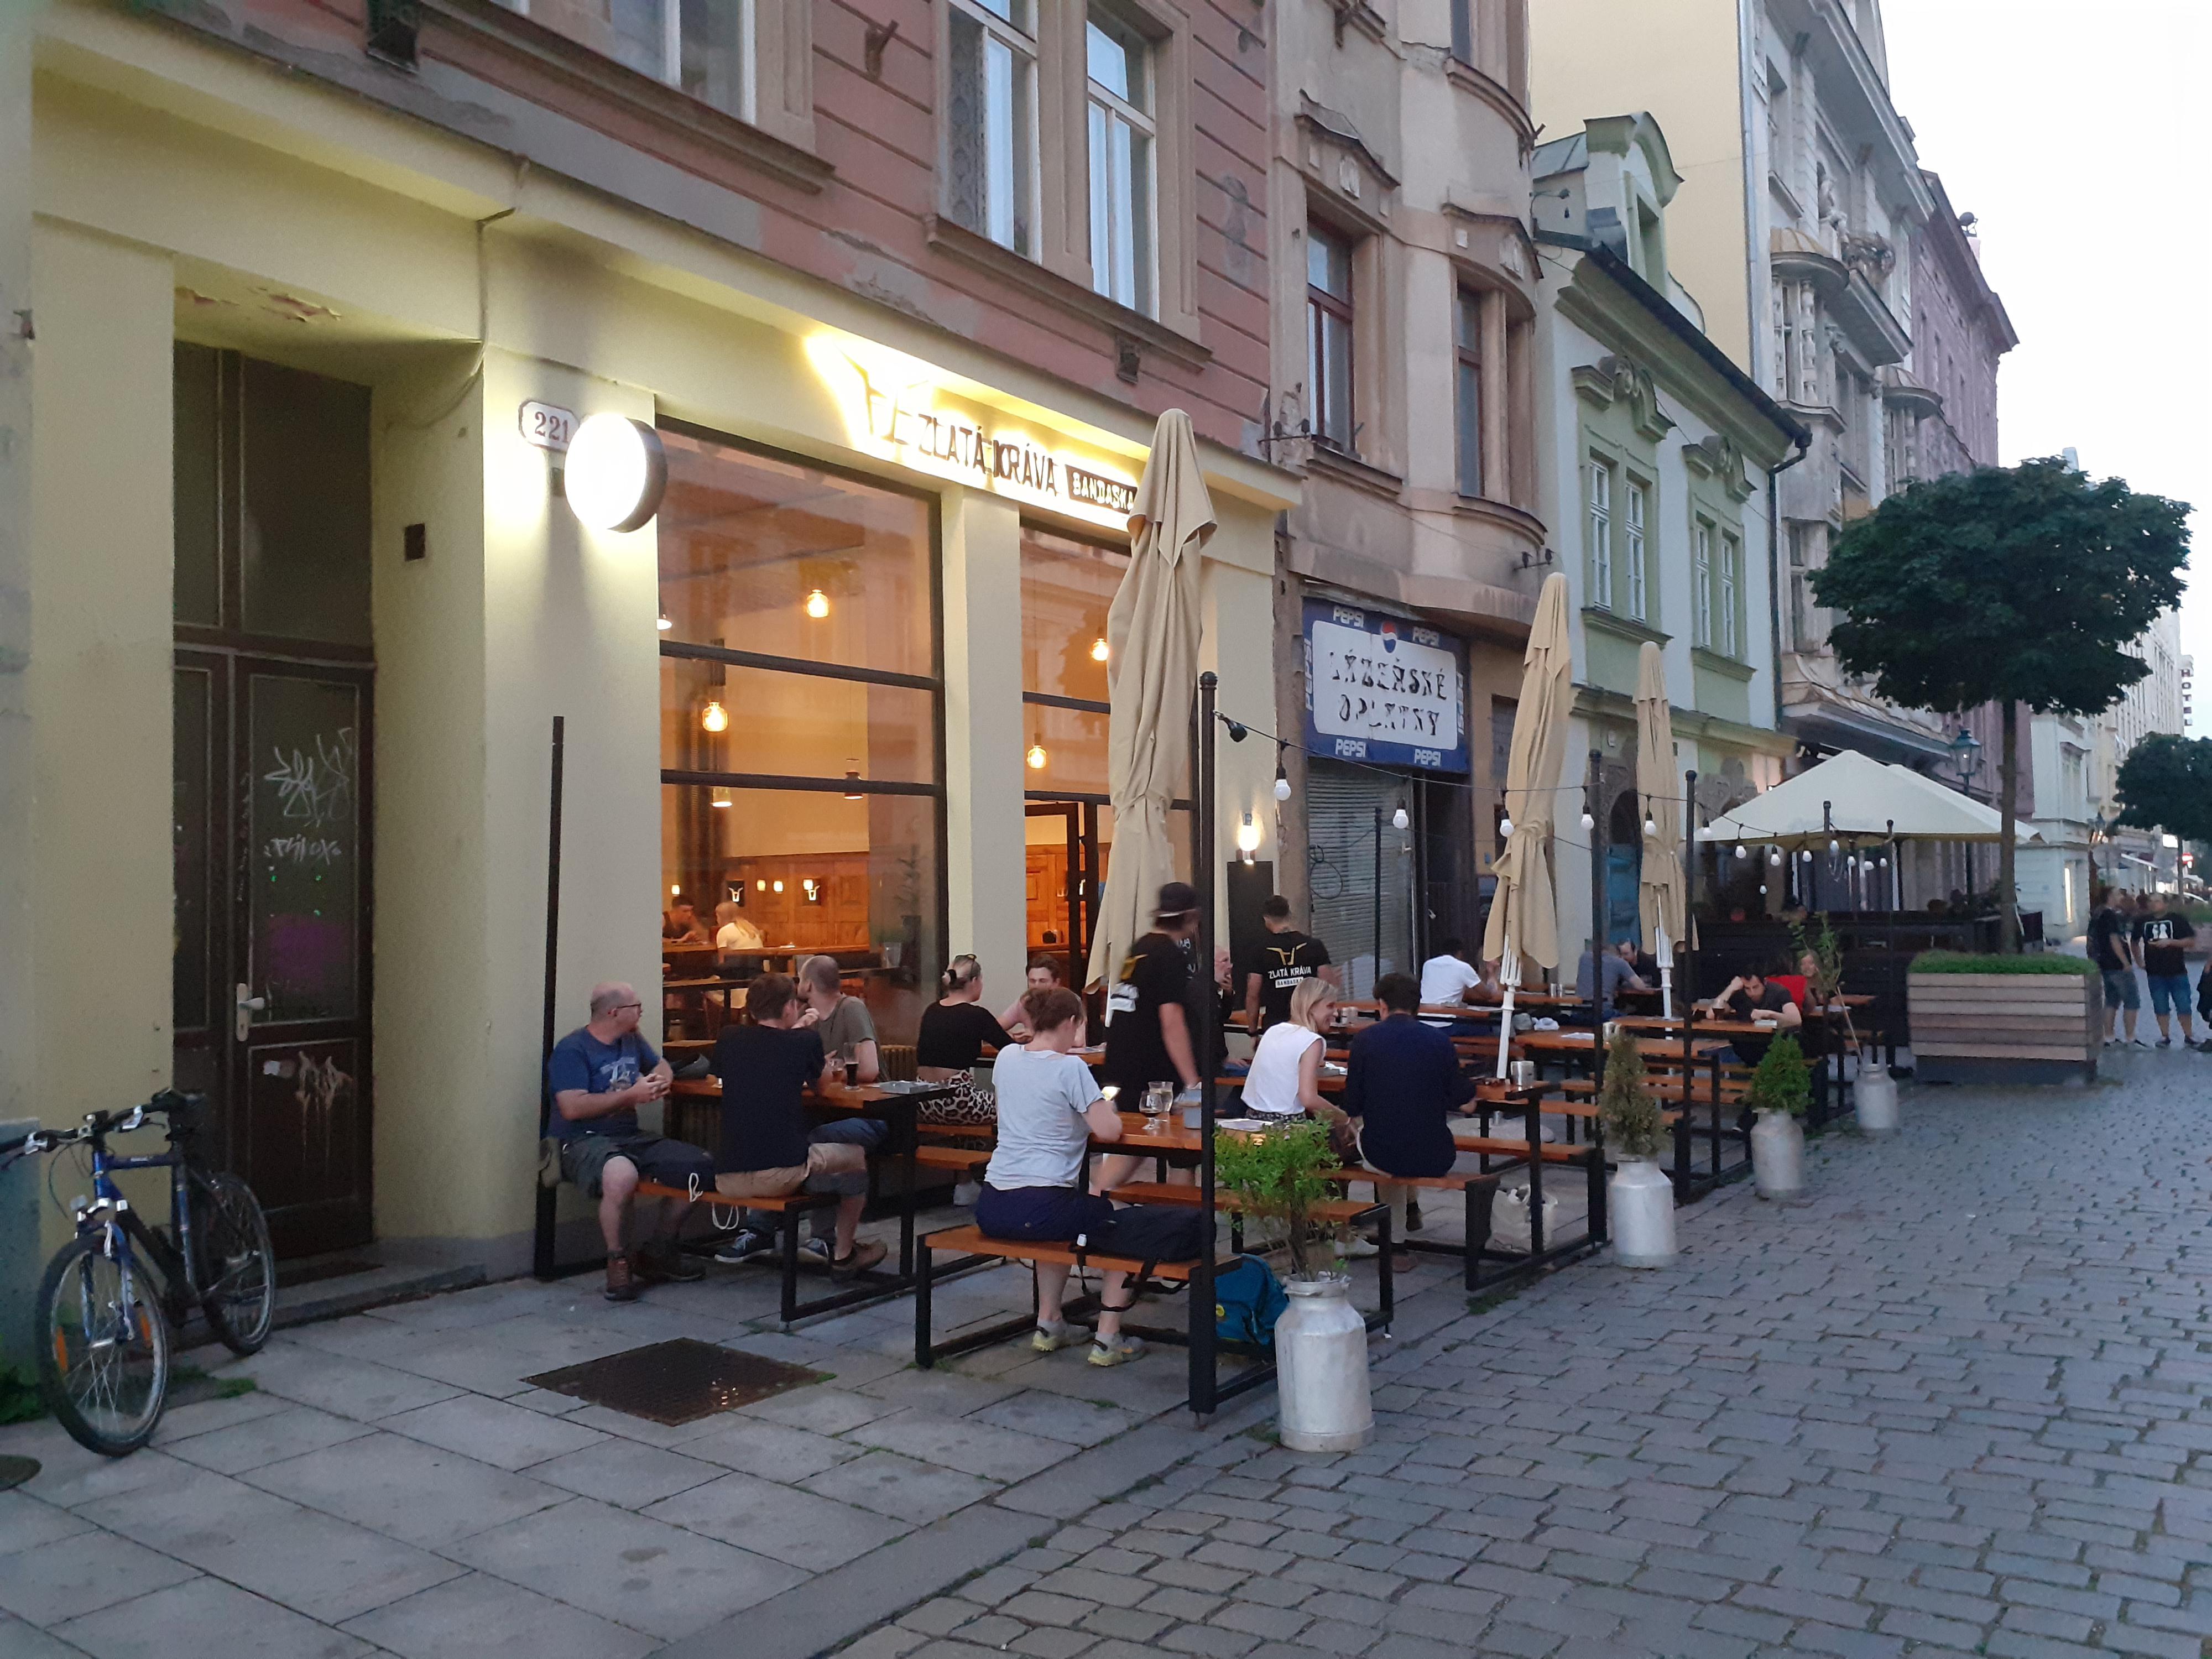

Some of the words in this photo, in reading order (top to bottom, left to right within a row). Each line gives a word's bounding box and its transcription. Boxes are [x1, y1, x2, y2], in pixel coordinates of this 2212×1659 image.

[534, 411, 568, 443] 221
[918, 414, 987, 475] ZLATÁ
[993, 440, 1057, 497] KRÁVA
[1072, 472, 1135, 511] BANDASKA
[1333, 605, 1364, 628] PEPSI
[2180, 669, 2192, 726] HOTEL
[1335, 738, 1366, 758] PEPSI
[1414, 749, 1441, 766] PEPSI
[1267, 967, 1288, 979] ZLATÁ
[1290, 966, 1312, 977] KRÁVA
